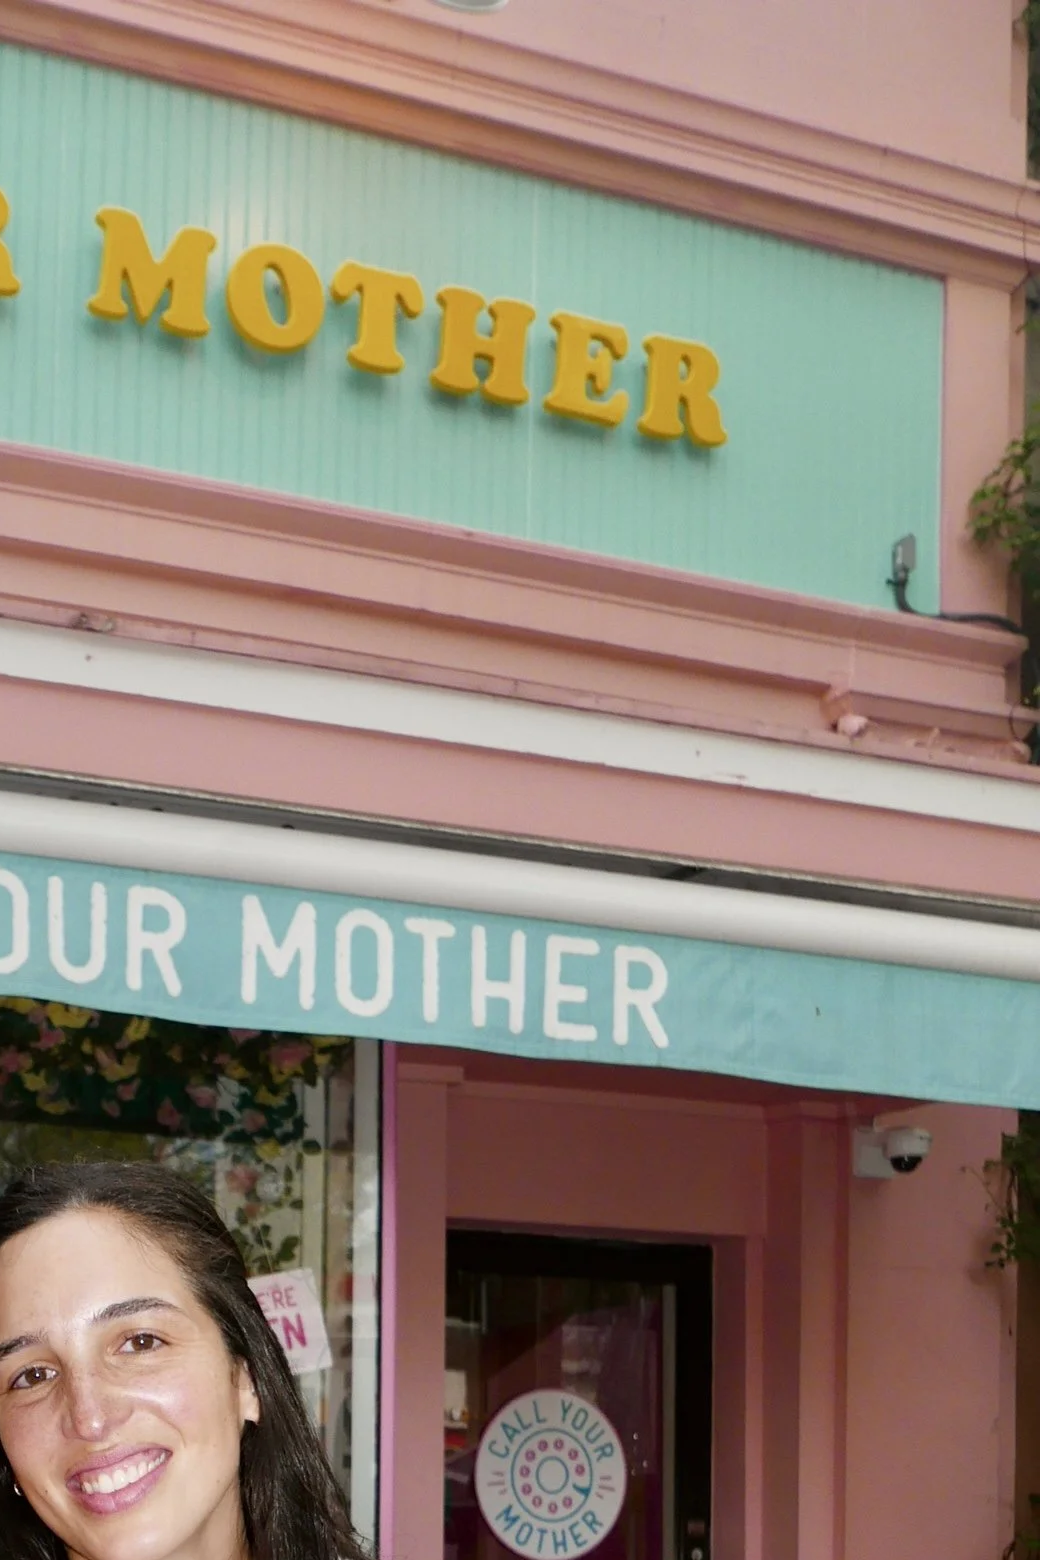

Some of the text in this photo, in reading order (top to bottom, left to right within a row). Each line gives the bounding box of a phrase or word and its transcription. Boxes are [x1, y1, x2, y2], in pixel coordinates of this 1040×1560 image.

[85, 206, 728, 447] MOTHER
[241, 894, 669, 1049] MOTHER
[488, 1400, 615, 1463] CALL YOUR
[494, 1504, 605, 1555] MOTHER
